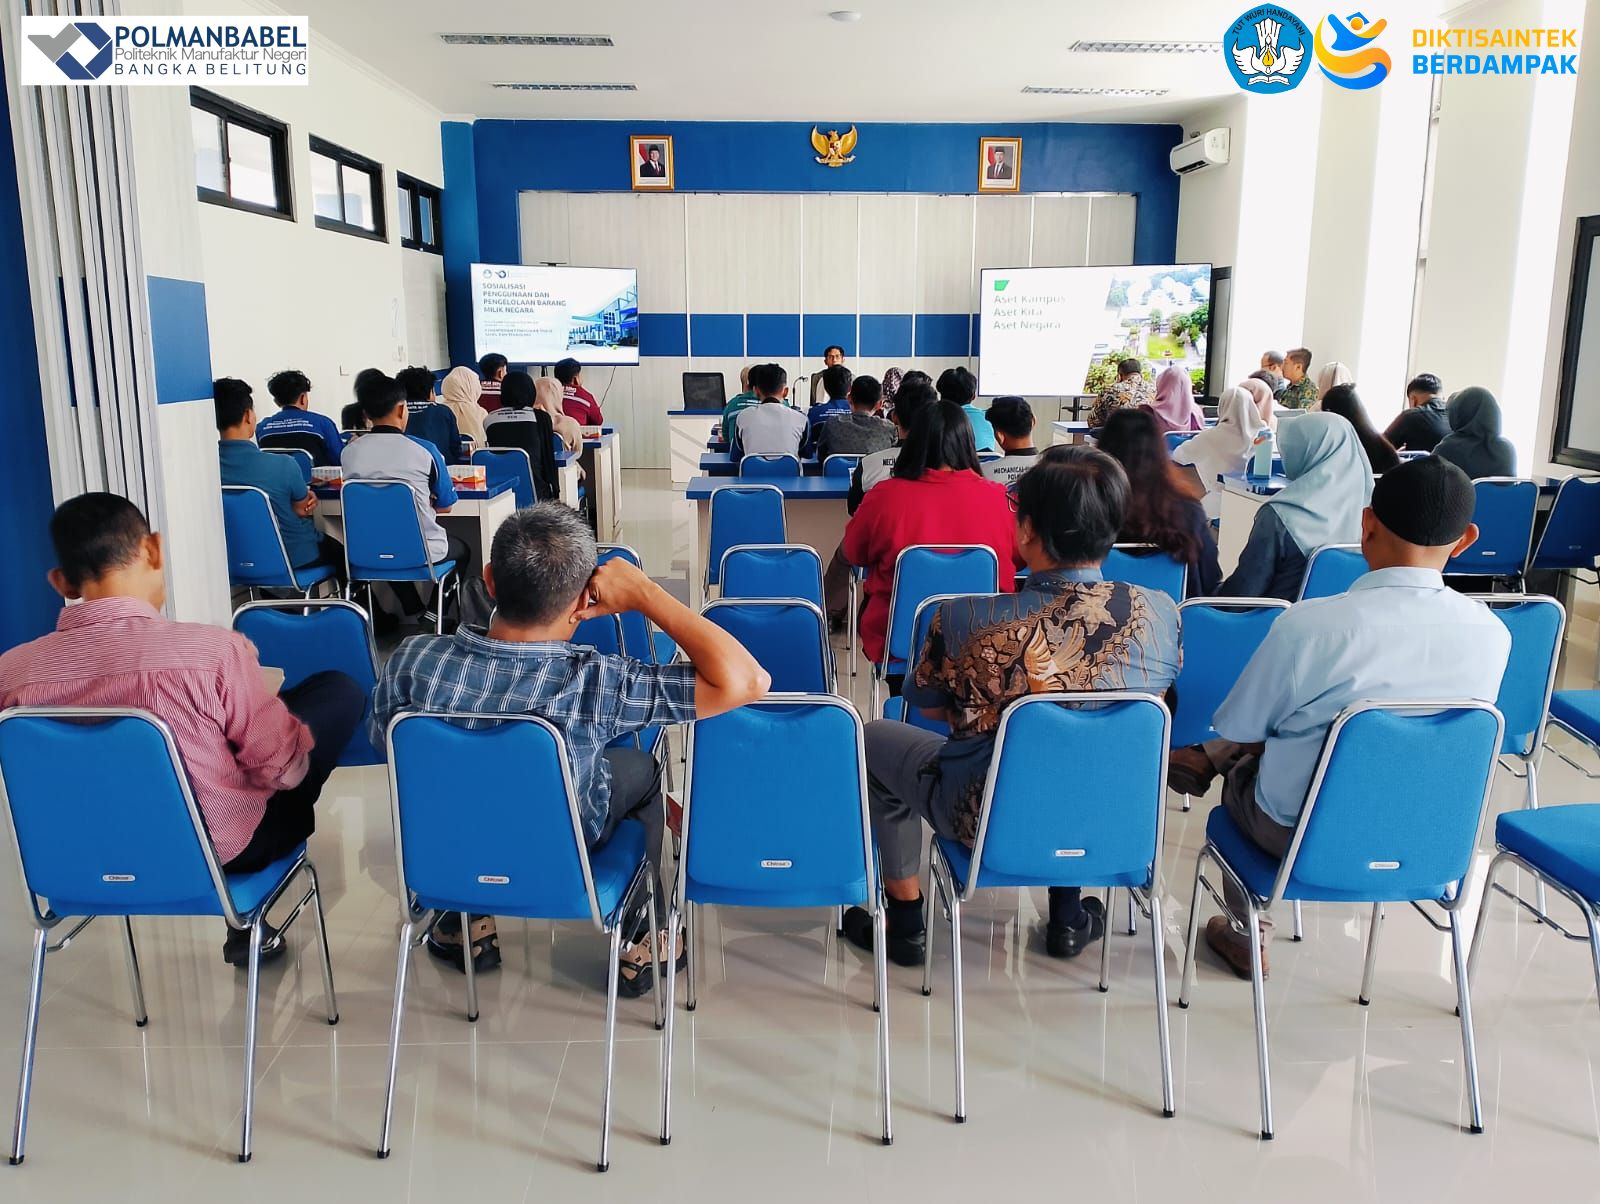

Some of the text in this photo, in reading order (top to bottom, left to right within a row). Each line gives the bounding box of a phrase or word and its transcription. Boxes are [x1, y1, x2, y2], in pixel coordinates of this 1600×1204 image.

[483, 290, 533, 298] PENGGUNAAN
[483, 298, 536, 306] PENGELOLAAN
[993, 295, 1017, 304] Aset
[992, 308, 1043, 317] Aset Kita
[992, 320, 1017, 329] Aset
